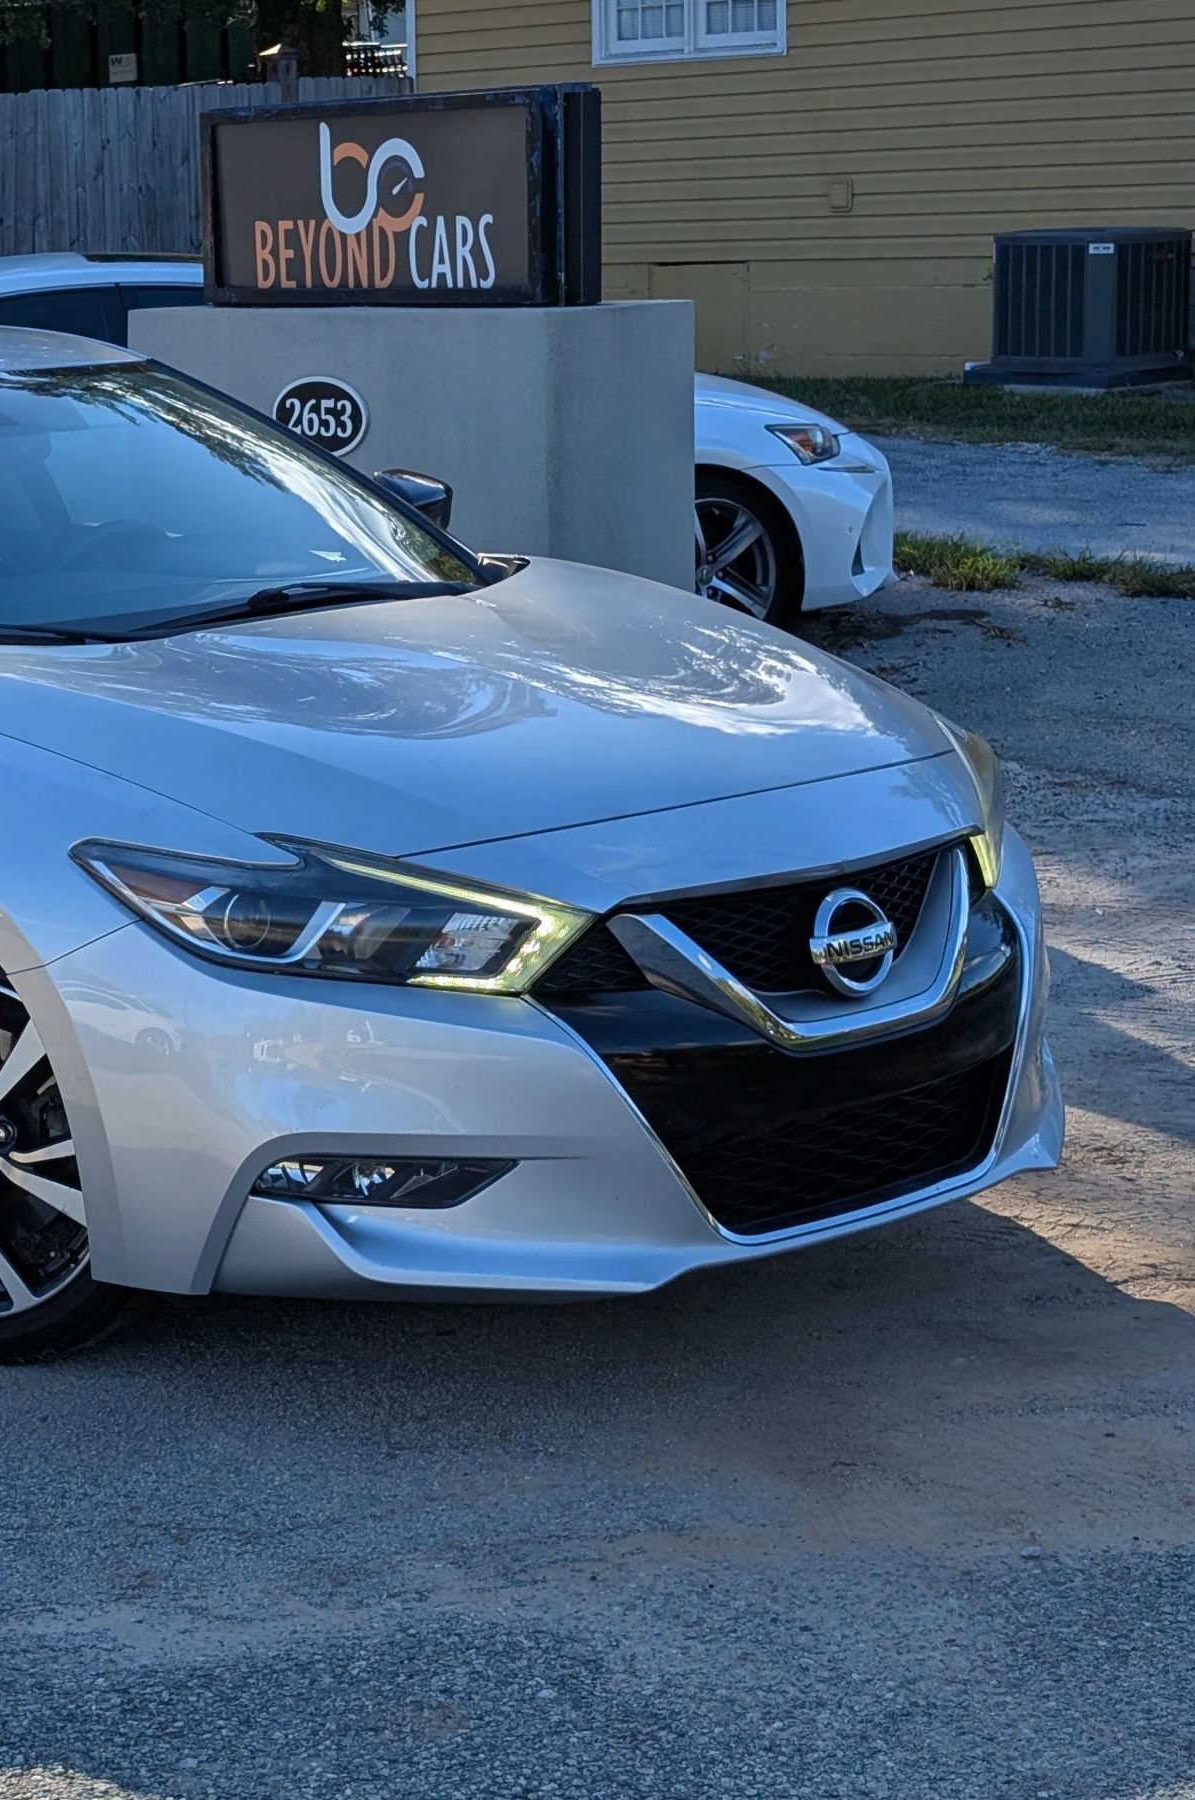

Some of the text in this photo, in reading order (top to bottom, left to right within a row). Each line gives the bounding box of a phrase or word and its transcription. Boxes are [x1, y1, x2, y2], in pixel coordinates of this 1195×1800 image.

[254, 213, 496, 290] BEYOND CARS
[285, 398, 353, 438] 2653
[827, 931, 894, 957] NISSAN
